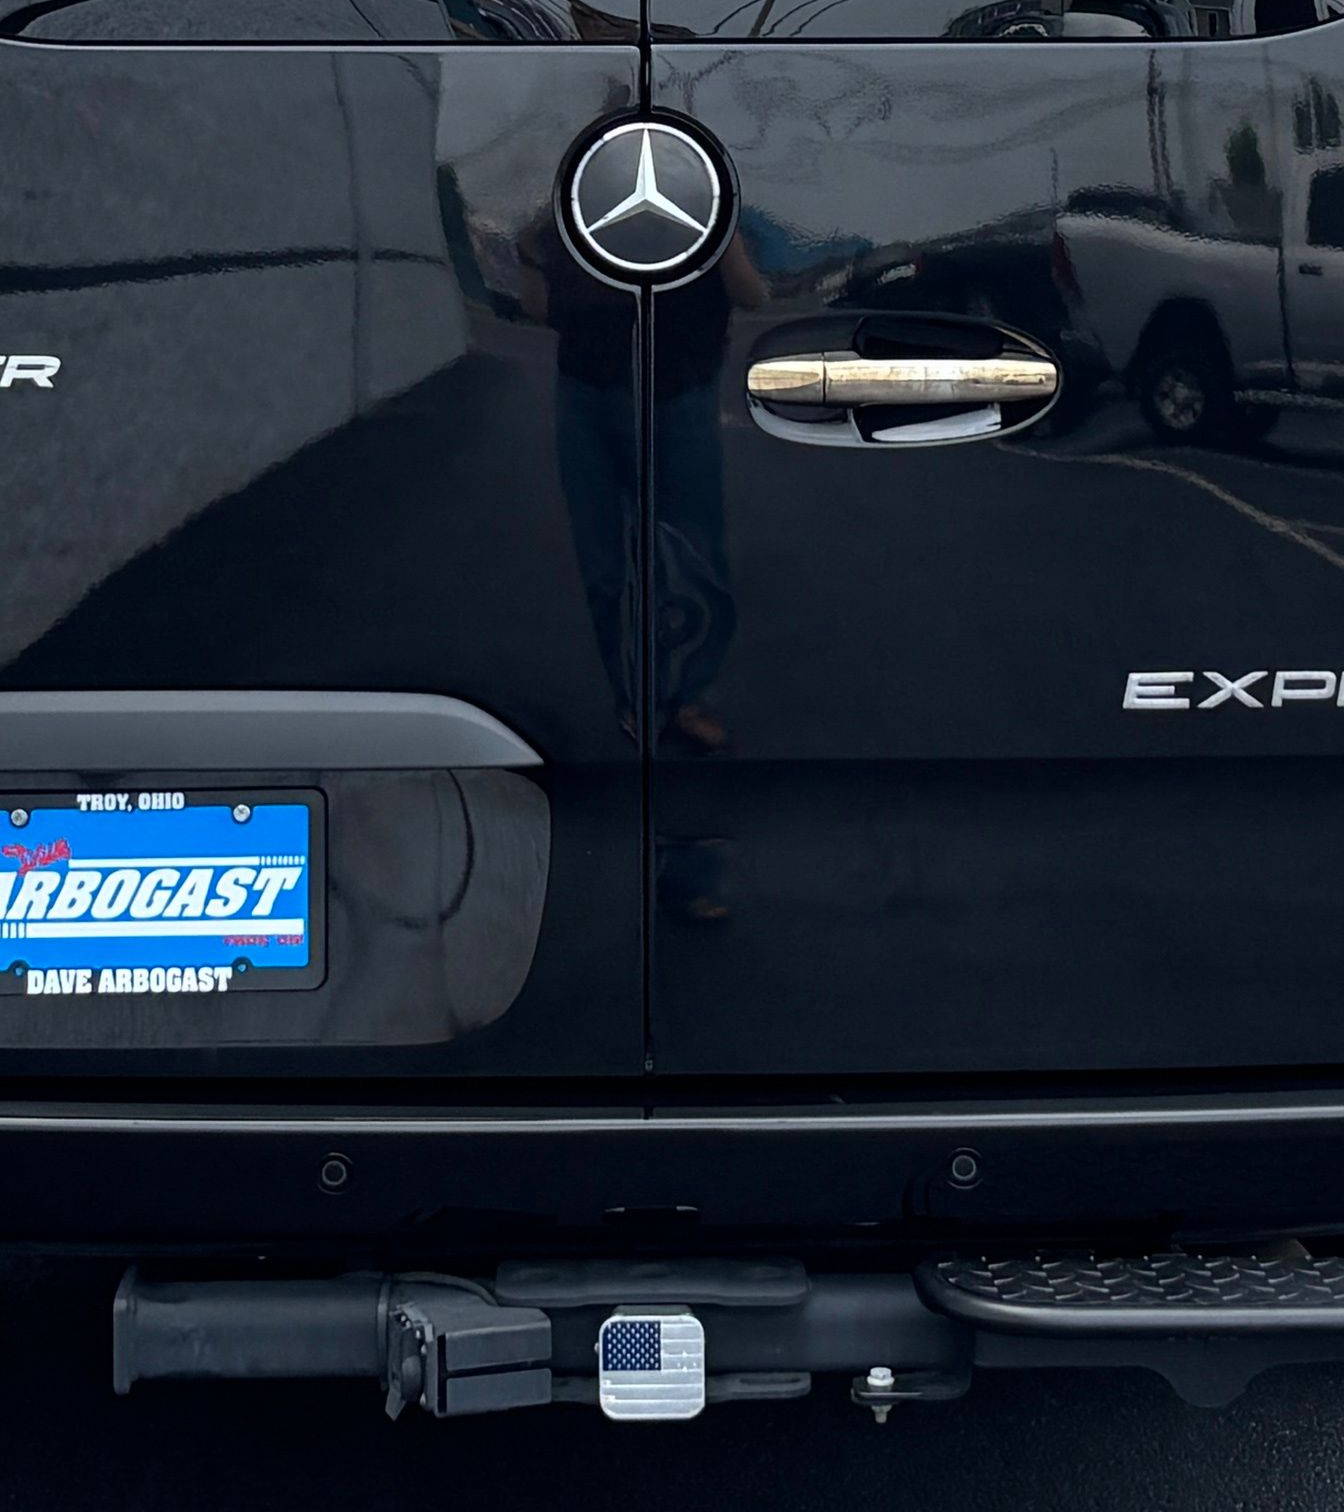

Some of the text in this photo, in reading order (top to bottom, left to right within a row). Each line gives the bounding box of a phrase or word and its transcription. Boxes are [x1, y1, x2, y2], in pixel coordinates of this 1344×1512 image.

[76, 791, 185, 813] TROY, OHIO
[26, 966, 233, 996] DAVE ARBOGAST
